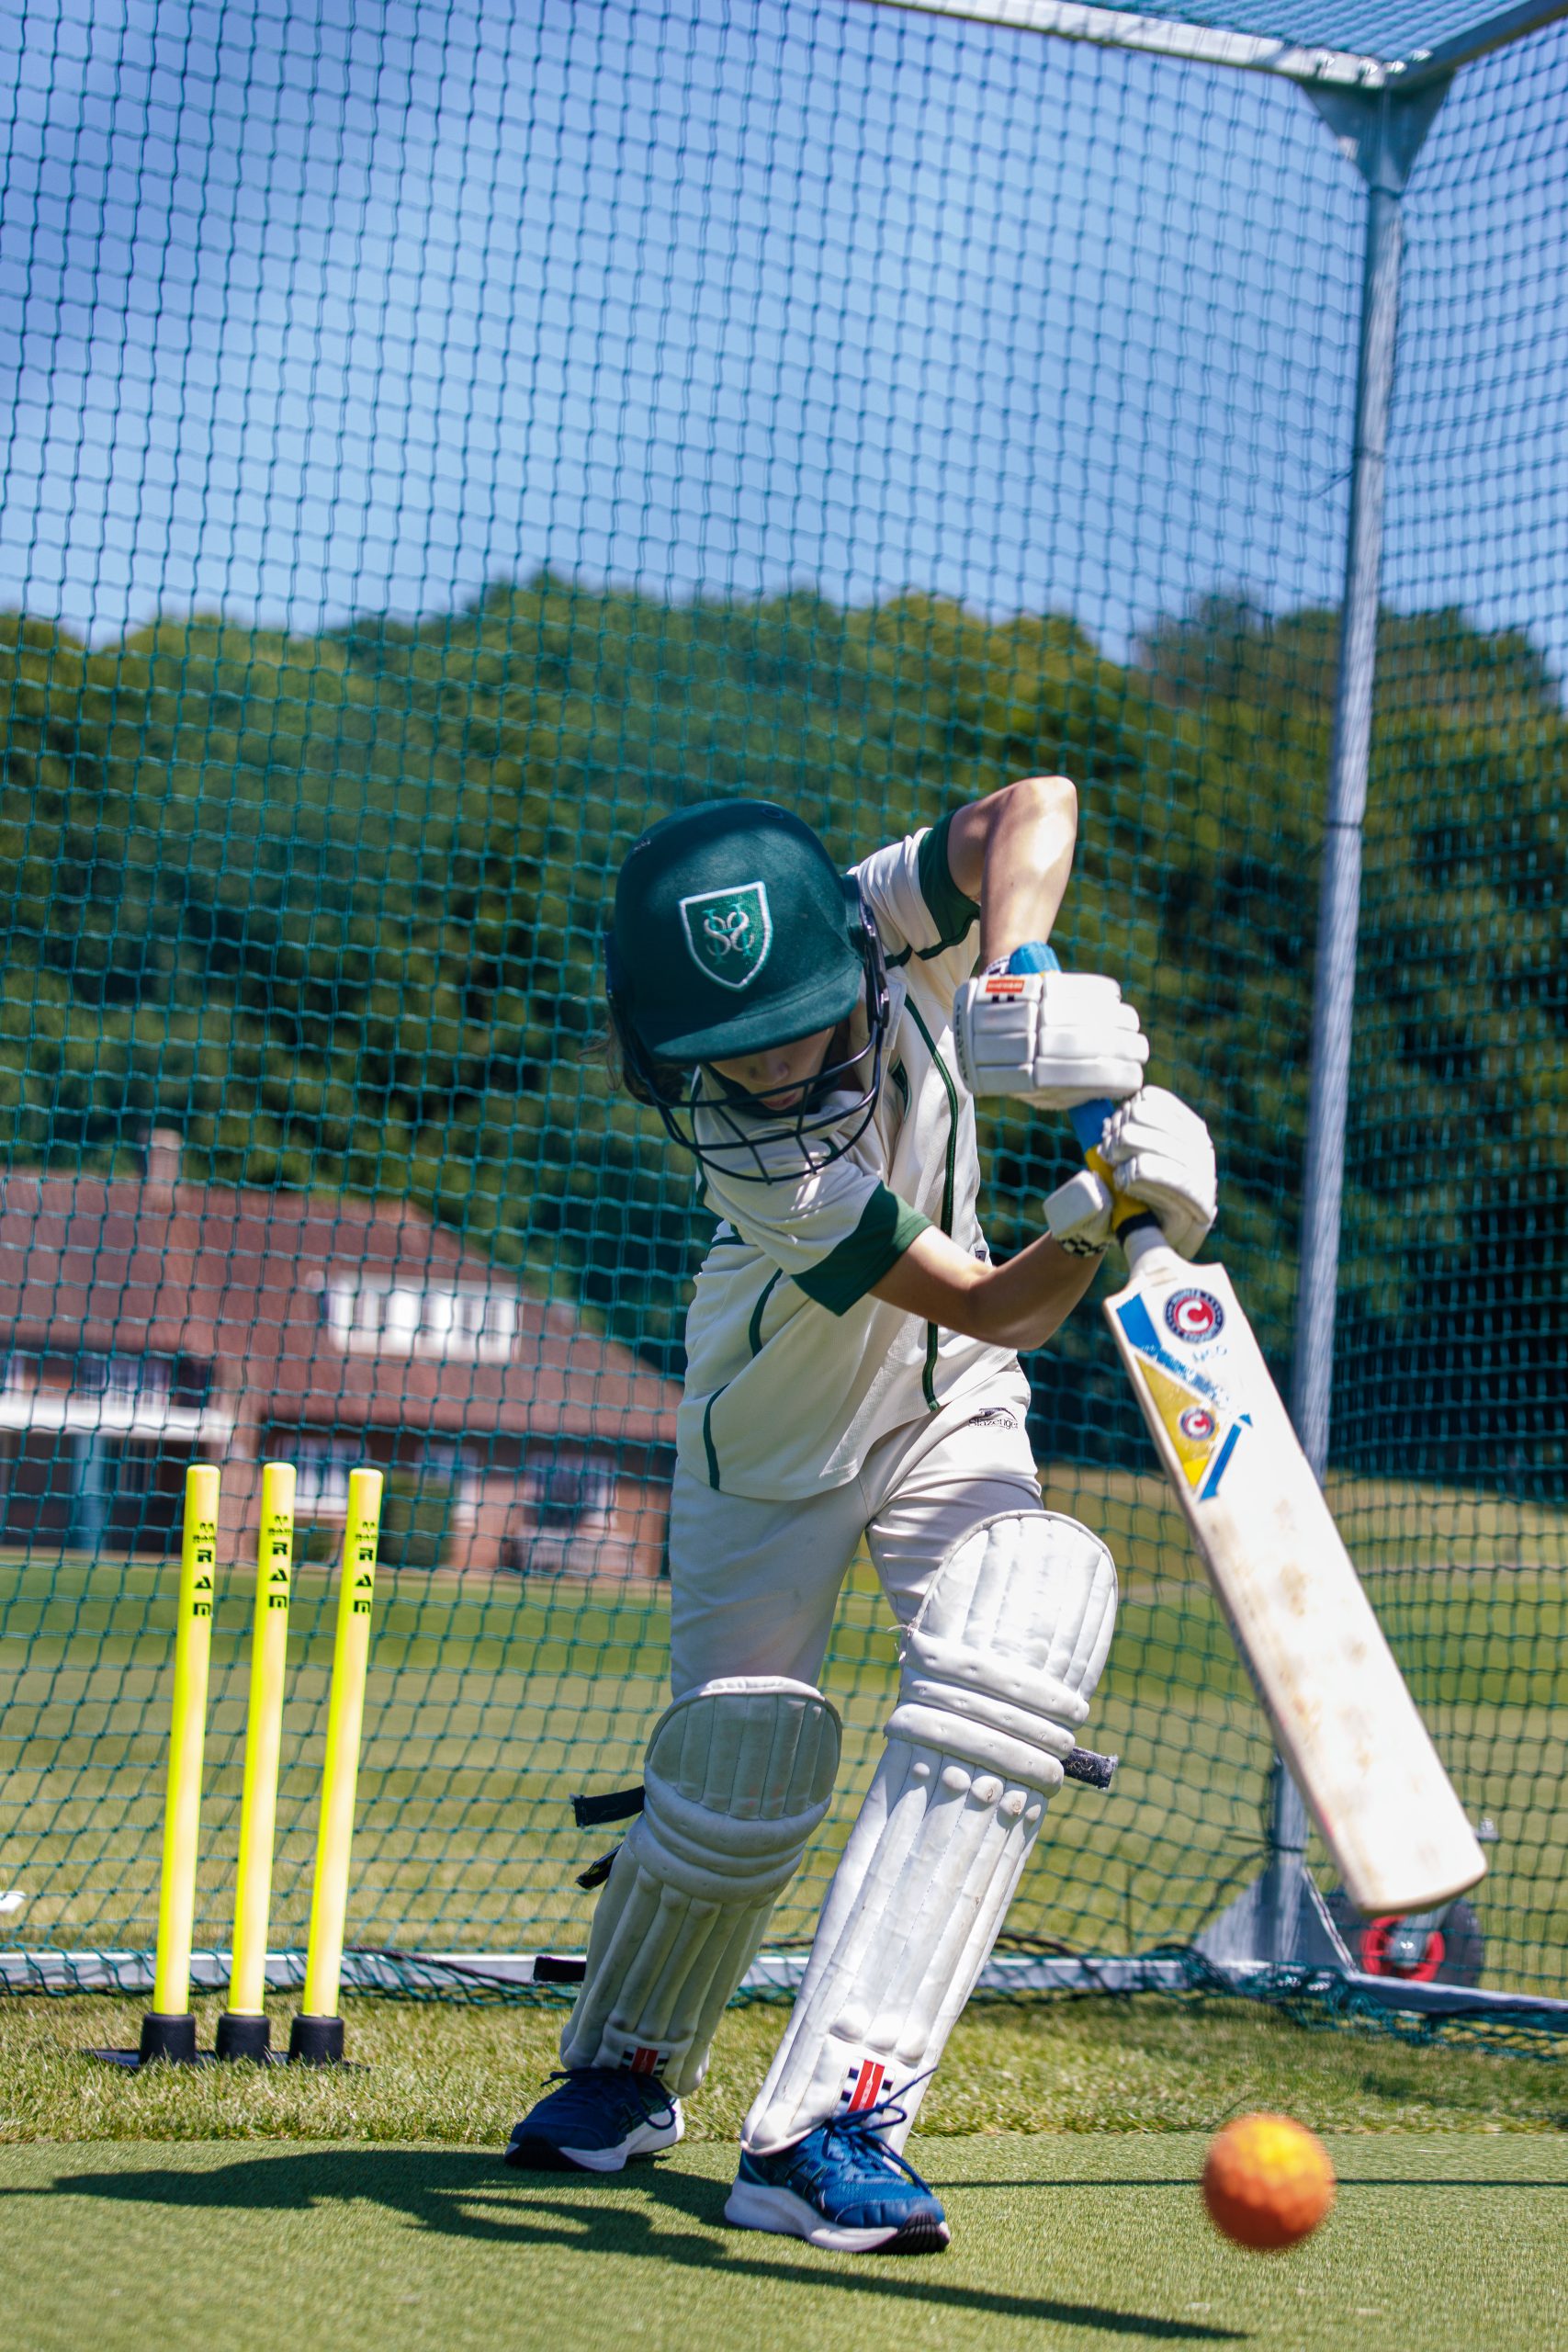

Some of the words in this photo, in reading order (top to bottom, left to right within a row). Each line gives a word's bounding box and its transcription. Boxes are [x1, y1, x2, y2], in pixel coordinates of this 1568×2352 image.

[1178, 1299, 1210, 1330] C
[193, 1549, 212, 1616] RAM
[268, 1542, 288, 1609] RAM
[354, 1548, 373, 1612] RAM
